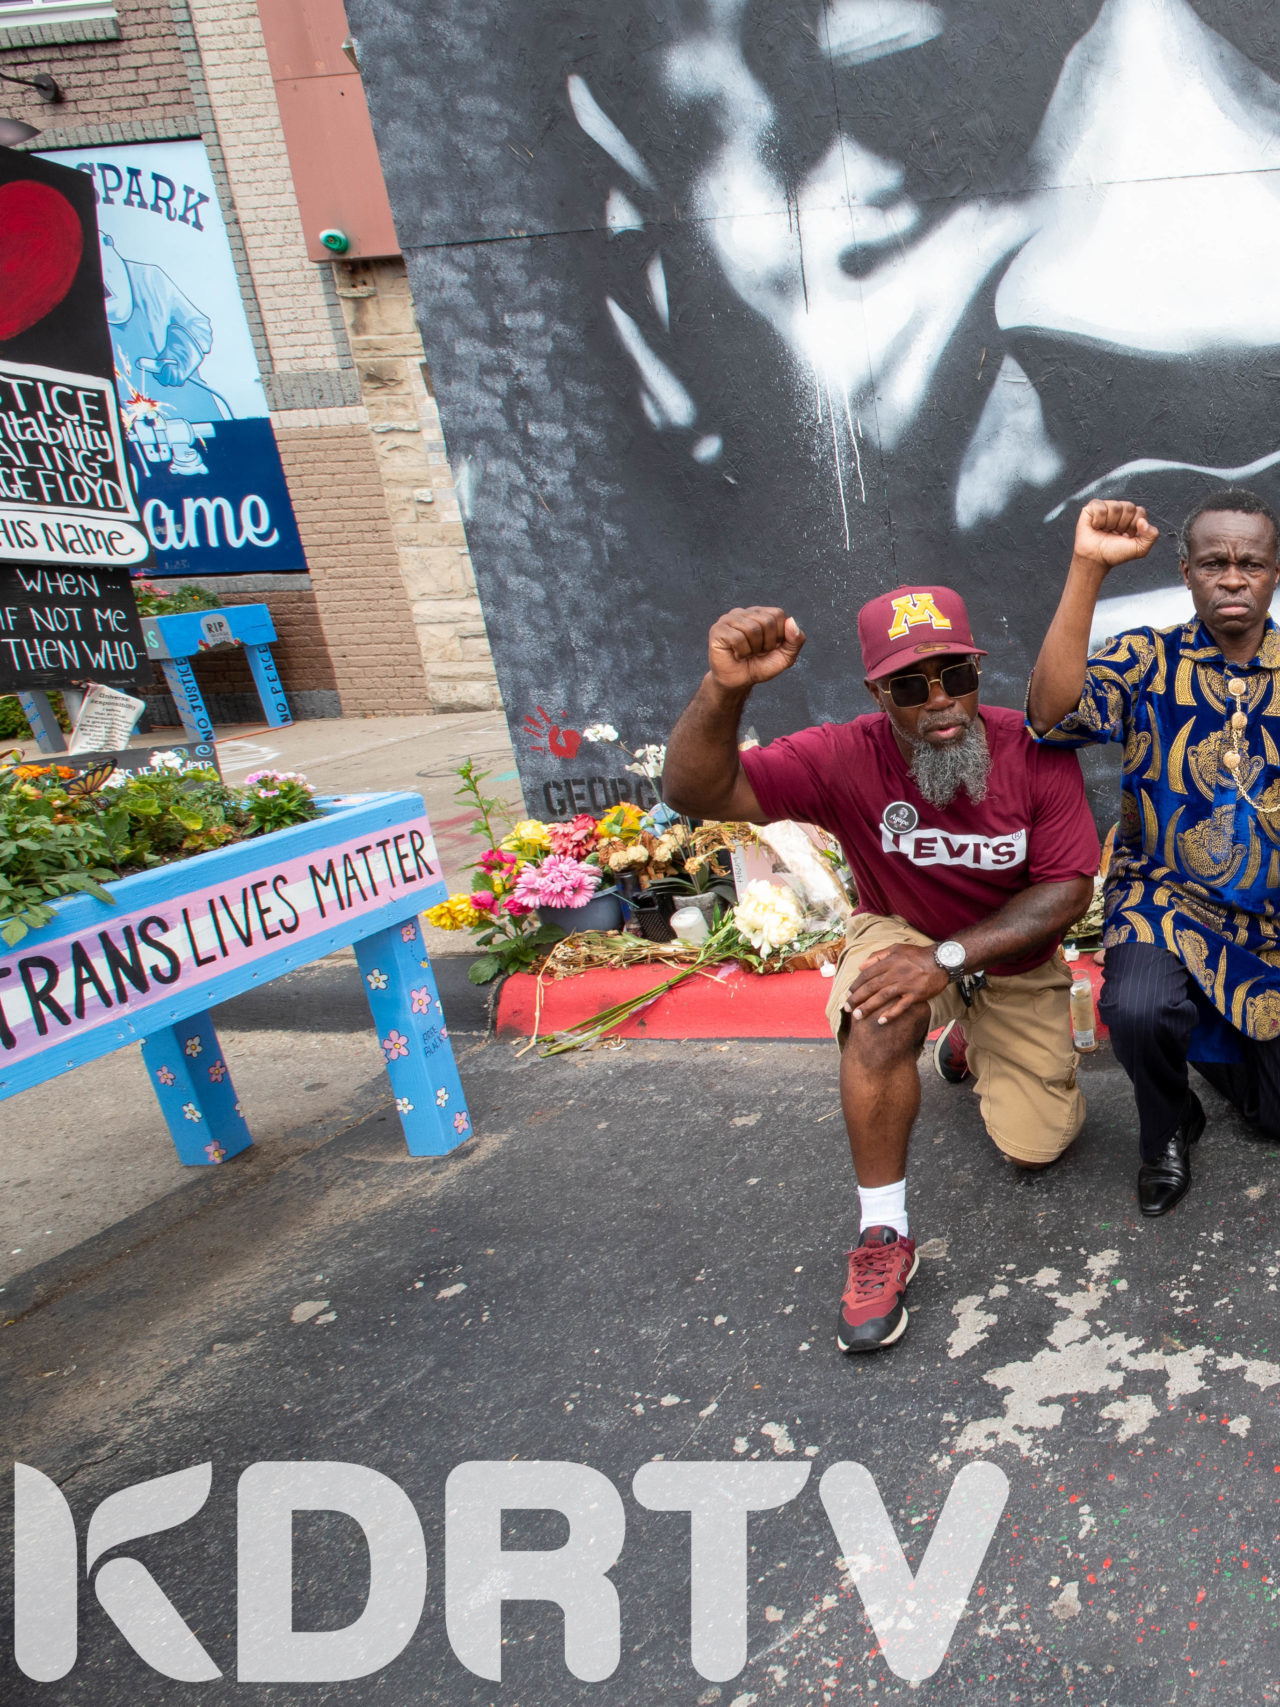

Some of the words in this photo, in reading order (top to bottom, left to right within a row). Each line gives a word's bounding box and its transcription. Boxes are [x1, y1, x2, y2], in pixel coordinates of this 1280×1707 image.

[36, 470, 126, 508] FLOYD
[136, 482, 280, 550] ame
[41, 522, 135, 556] Name
[29, 607, 82, 631] NOT
[206, 621, 224, 633] RIP
[888, 593, 952, 640] M
[175, 657, 203, 713] JUSTICE
[258, 643, 283, 695] PEACE
[197, 717, 214, 742] NO
[276, 702, 291, 723] NO
[182, 874, 300, 968] LIVES
[308, 829, 435, 919] MATTER
